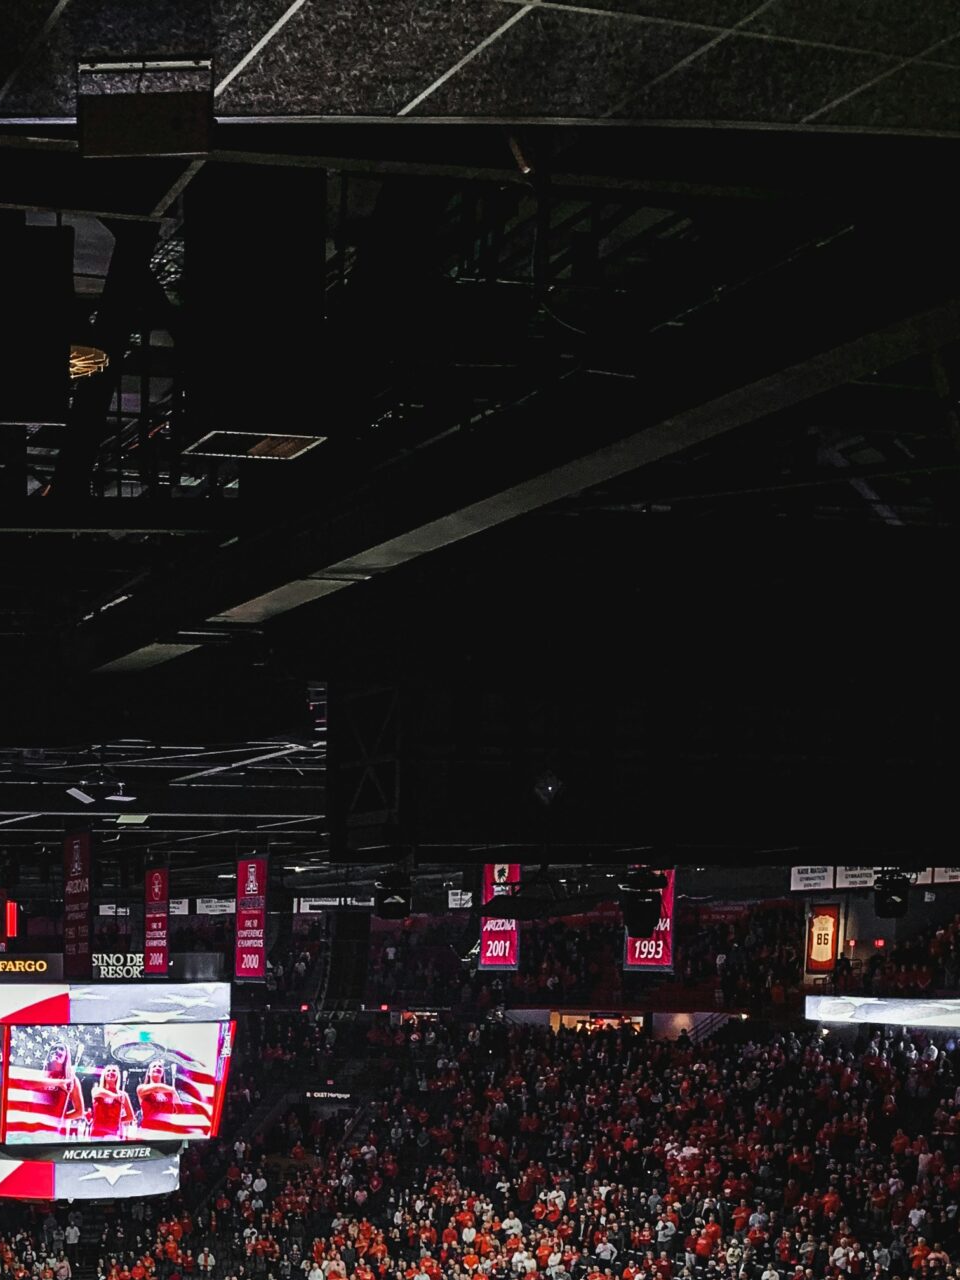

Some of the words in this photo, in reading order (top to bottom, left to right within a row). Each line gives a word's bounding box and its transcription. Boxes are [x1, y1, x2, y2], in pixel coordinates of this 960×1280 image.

[483, 919, 516, 931] ARIZONA
[816, 933, 829, 945] 86
[486, 940, 510, 957] 2001
[635, 940, 663, 958] 1993
[92, 953, 124, 966] SINO
[149, 953, 163, 966] 2004
[241, 954, 259, 968] 2000
[63, 1149, 111, 1159] MCKALE
[112, 1147, 151, 1159] CENTER
